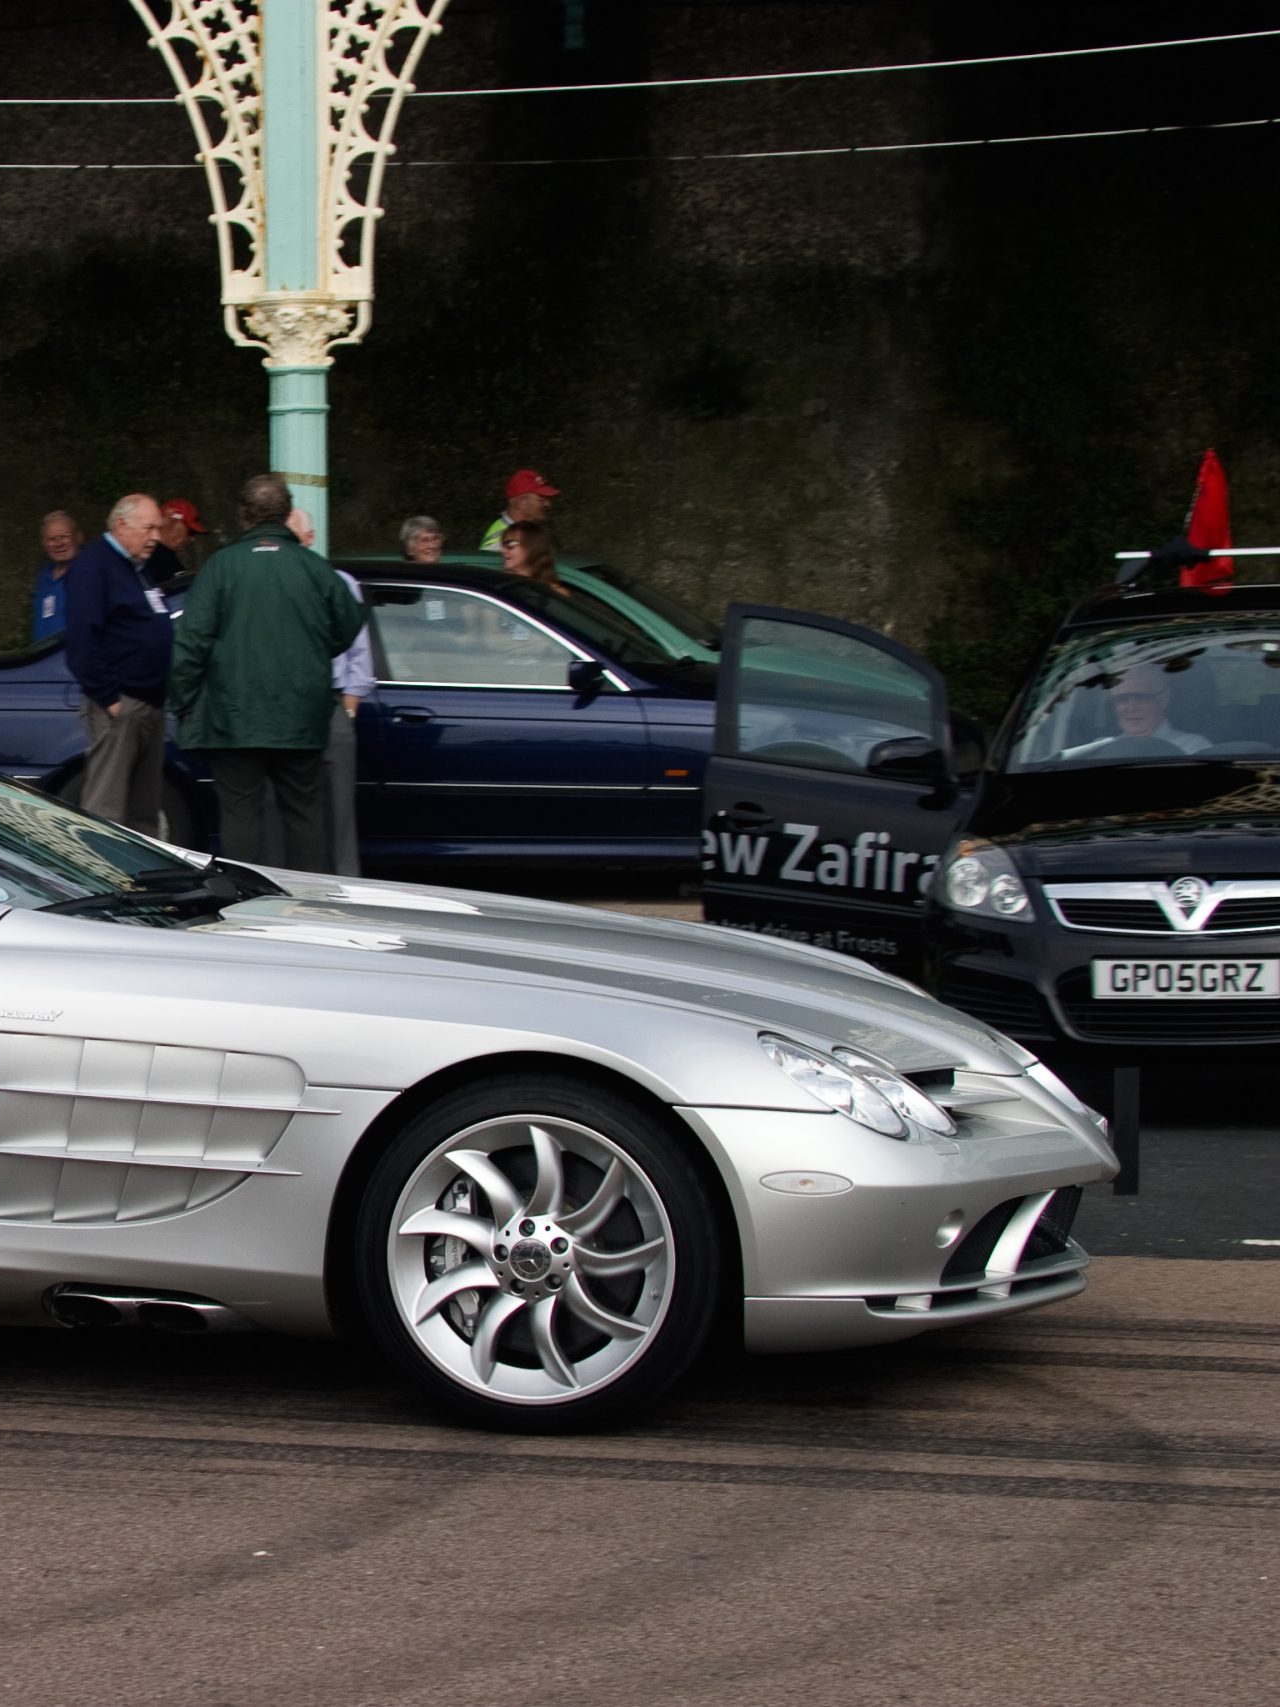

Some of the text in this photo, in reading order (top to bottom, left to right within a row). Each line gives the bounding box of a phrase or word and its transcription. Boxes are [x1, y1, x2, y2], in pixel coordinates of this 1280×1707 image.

[701, 829, 770, 876] ew
[814, 931, 834, 948] at
[835, 930, 898, 954] Frosts
